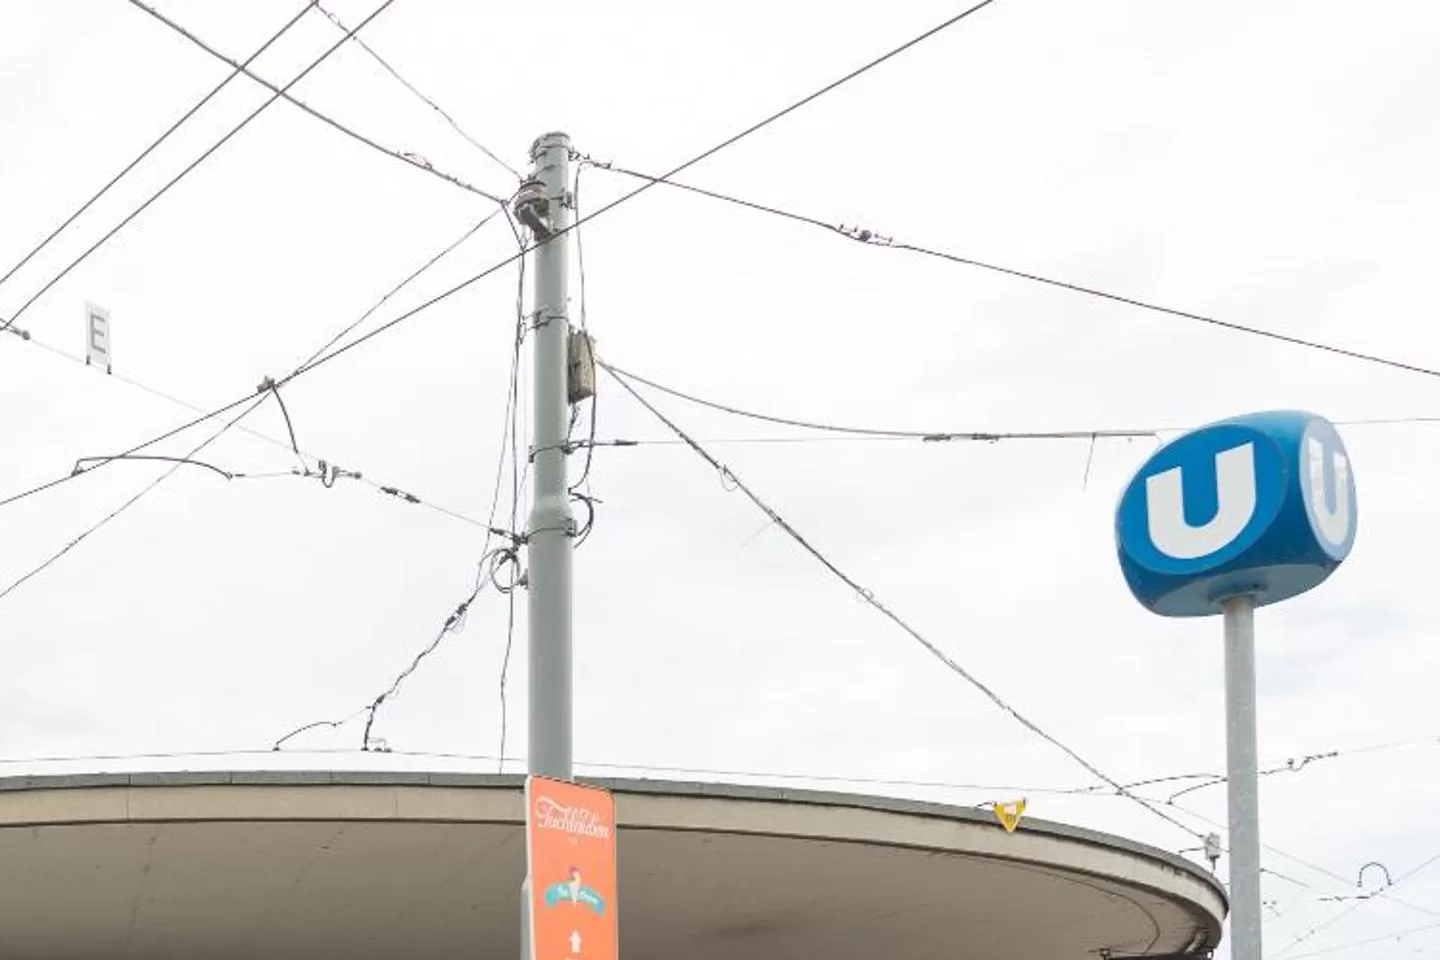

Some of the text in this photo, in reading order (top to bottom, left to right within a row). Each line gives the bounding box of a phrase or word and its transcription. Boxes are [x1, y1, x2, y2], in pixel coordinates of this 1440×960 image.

[90, 309, 107, 354] E
[1145, 440, 1257, 560] U
[1308, 437, 1349, 546] U
